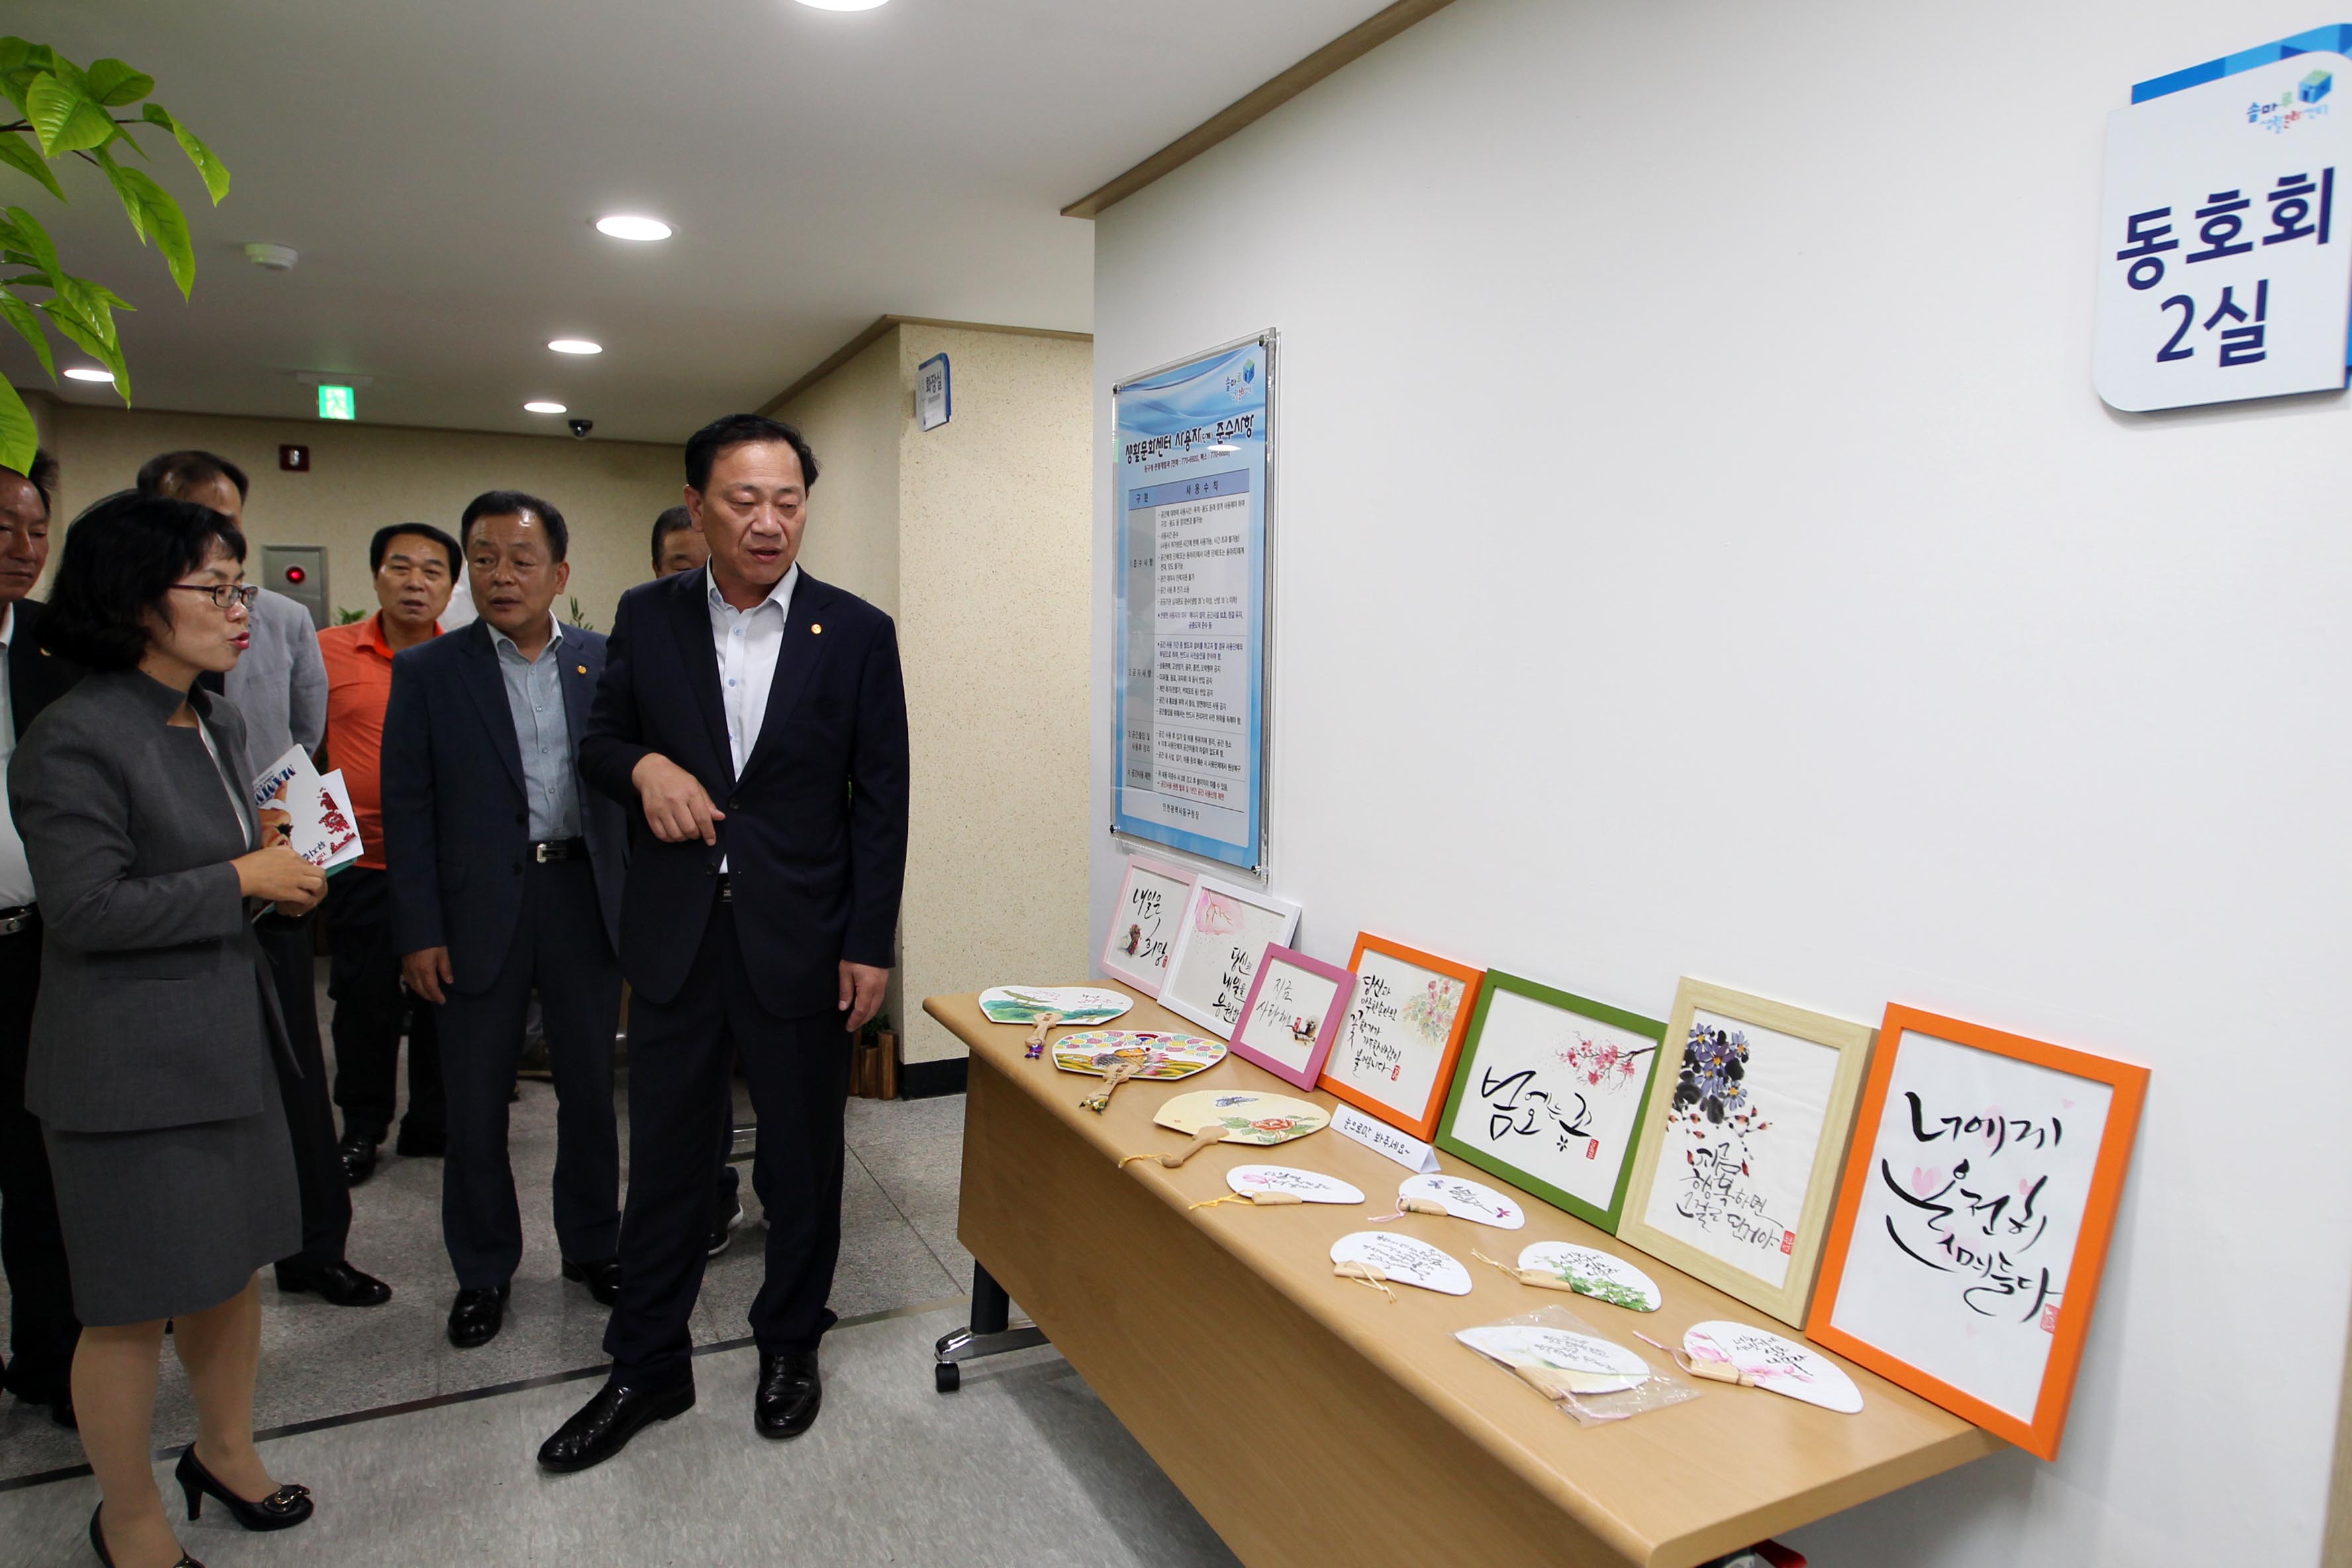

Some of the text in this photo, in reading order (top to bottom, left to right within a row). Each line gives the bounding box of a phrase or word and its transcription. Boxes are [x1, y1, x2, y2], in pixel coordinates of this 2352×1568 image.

[2116, 166, 2335, 290] 동호회
[2157, 278, 2269, 368] 2실
[1125, 434, 1171, 465] 생활문화센터
[1215, 413, 1254, 445] 준수사항
[1140, 938, 1167, 967] 희망
[1344, 1119, 1372, 1138] 눈으로만
[1904, 1091, 2063, 1157] 너에게
[1696, 1142, 1741, 1176] 지금
[1679, 1169, 1784, 1228] 행복하면
